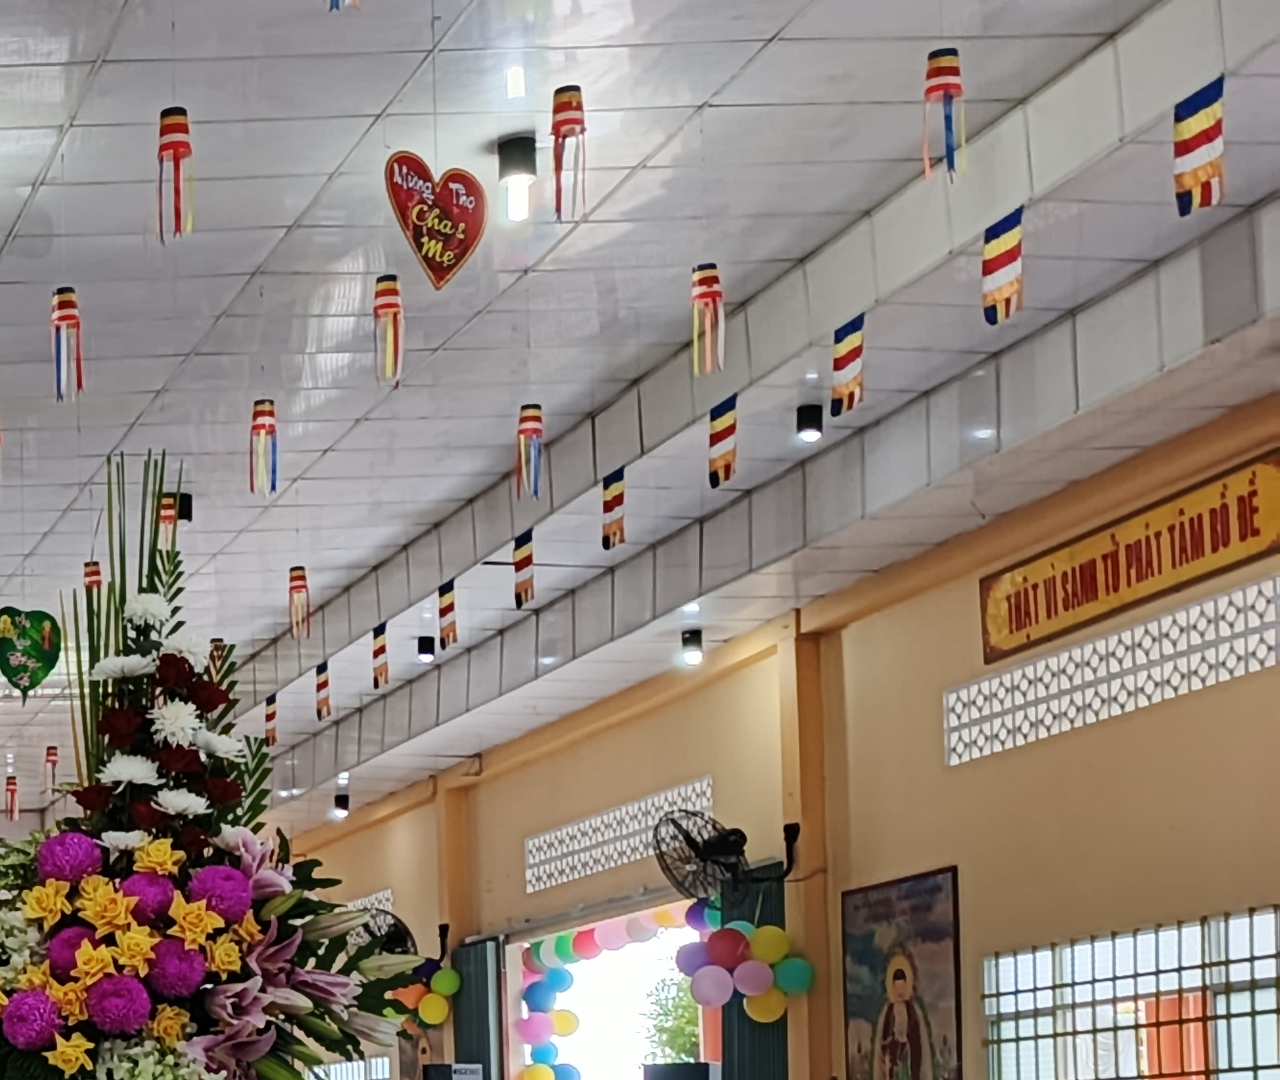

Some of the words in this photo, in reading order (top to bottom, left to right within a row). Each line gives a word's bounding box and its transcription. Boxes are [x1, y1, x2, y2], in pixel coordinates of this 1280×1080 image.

[412, 204, 455, 235] Cha
[421, 235, 455, 267] Mẹ
[1043, 562, 1059, 620] VÌ
[1060, 558, 1099, 612] SANH
[1124, 522, 1163, 588] PHÁT
[1167, 507, 1206, 570] TÂM
